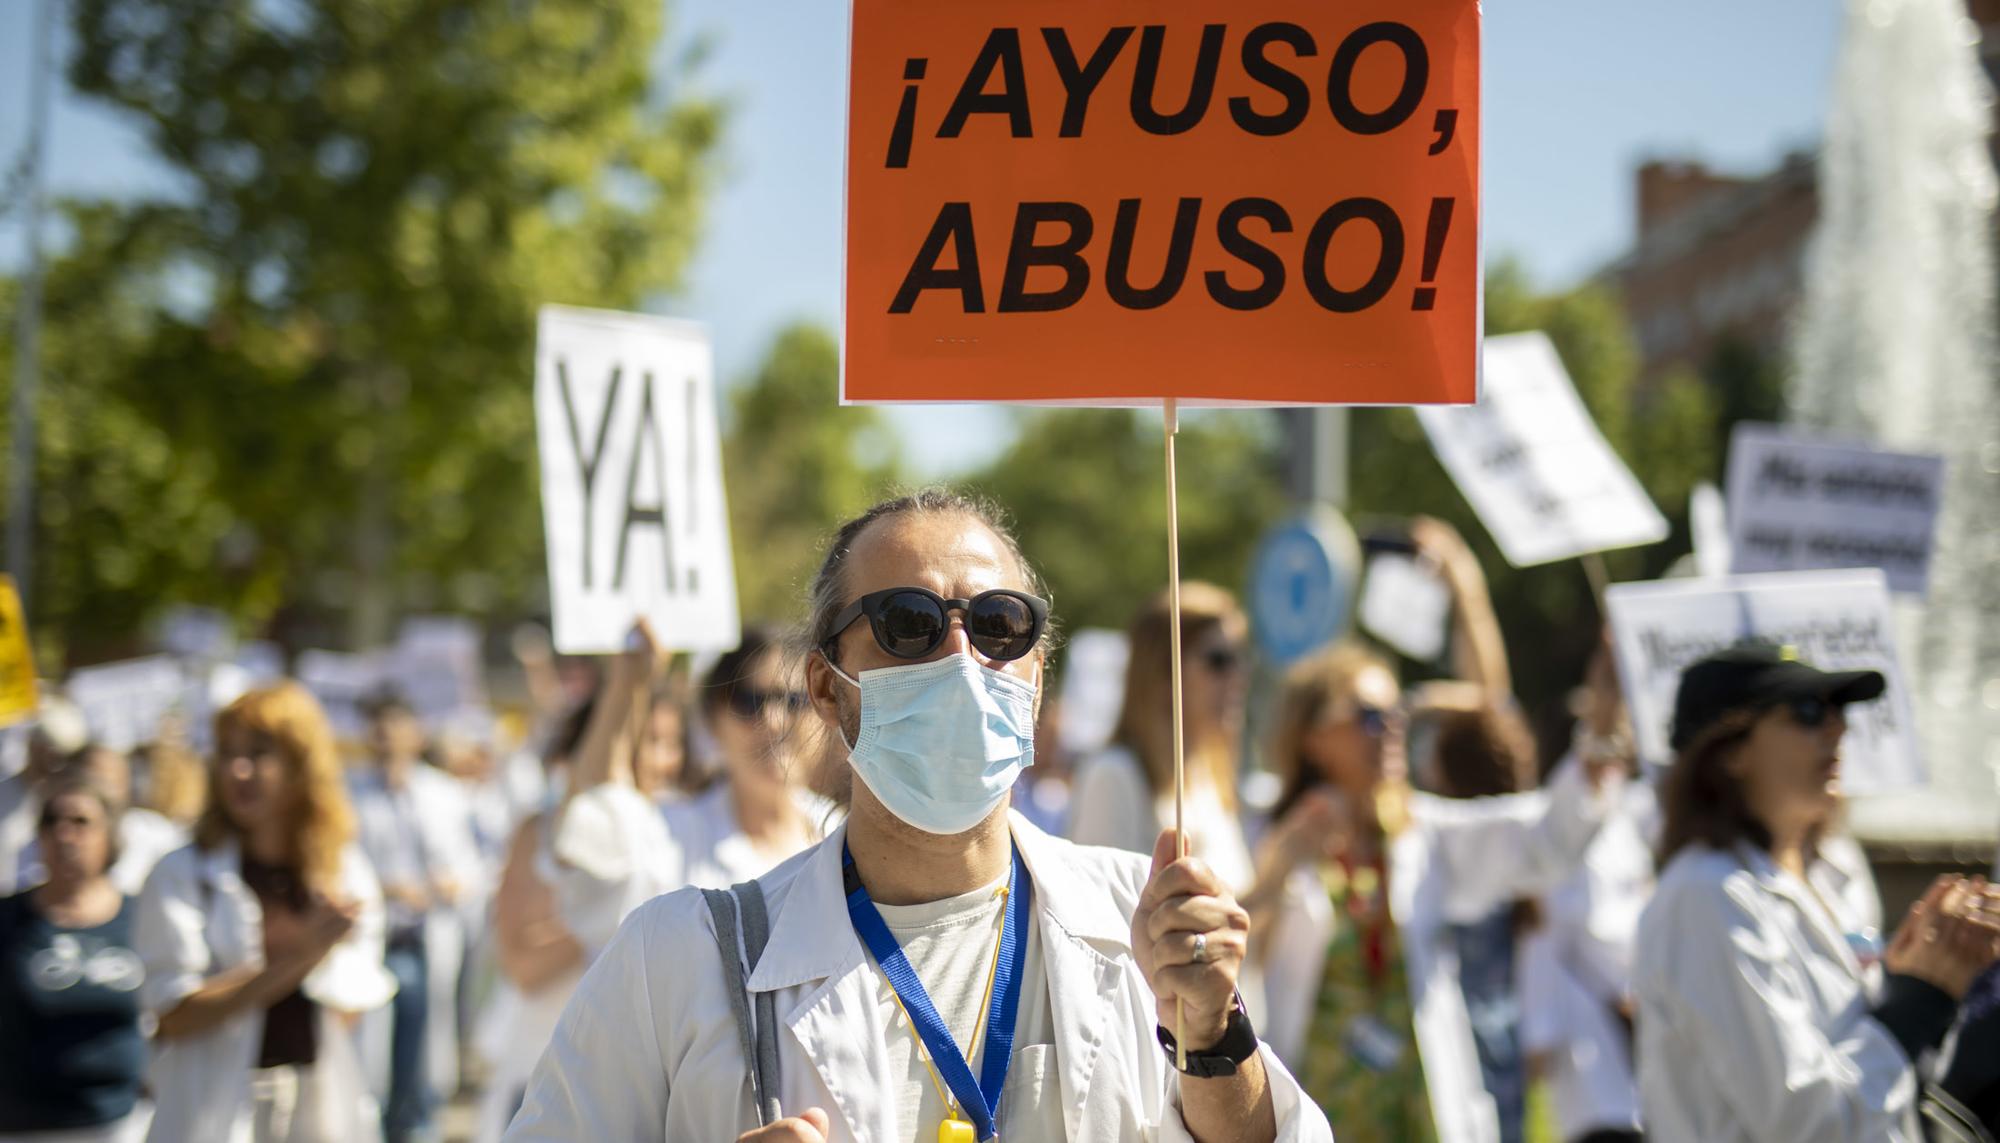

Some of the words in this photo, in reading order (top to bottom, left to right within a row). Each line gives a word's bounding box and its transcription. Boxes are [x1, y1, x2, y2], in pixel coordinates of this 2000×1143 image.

[885, 21, 1459, 169] ¡AYUSO,
[887, 197, 1455, 314] ABUSO!
[555, 358, 699, 592] YA!
